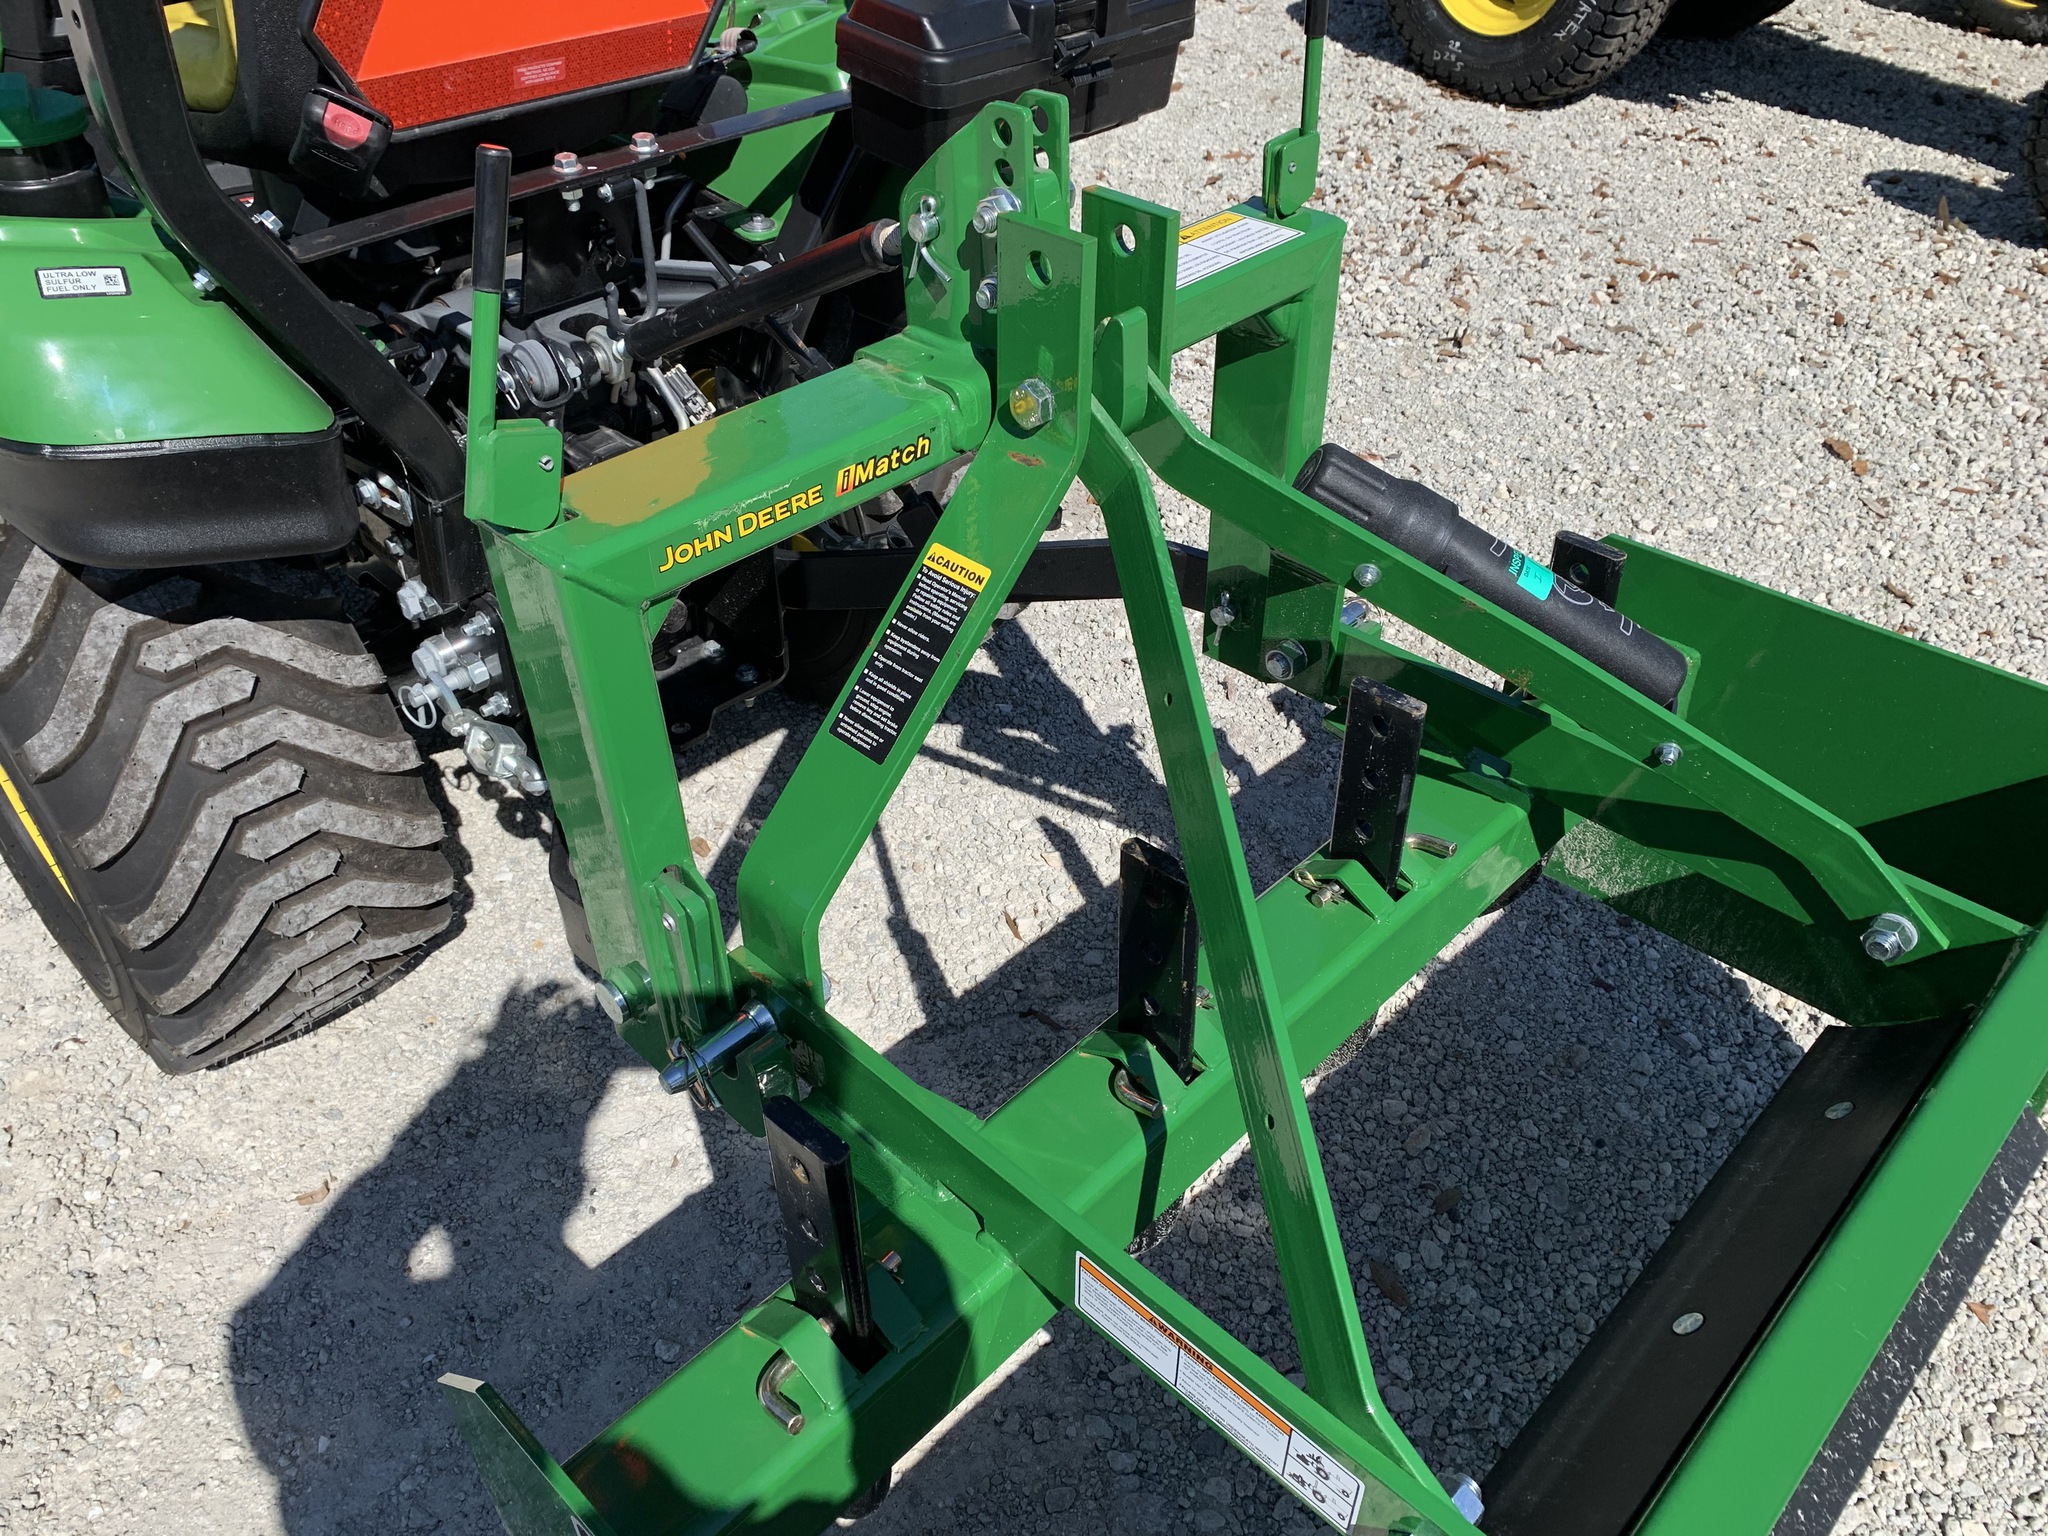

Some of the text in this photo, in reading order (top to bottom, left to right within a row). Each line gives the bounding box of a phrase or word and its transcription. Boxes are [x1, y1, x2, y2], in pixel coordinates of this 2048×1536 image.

[1553, 0, 1597, 41] ATER
[659, 525, 733, 573] JOHN
[737, 484, 824, 538] DEERE
[935, 555, 985, 586] CAUTION
[928, 571, 942, 580] Avoid
[942, 578, 960, 590] Serious
[960, 587, 976, 598] Injury:
[897, 621, 908, 629] Never
[891, 632, 900, 640] Keep
[921, 650, 931, 658] away
[878, 655, 892, 665] Operate
[869, 671, 878, 679] Keep
[859, 688, 871, 697] Lower
[871, 696, 890, 708] equipment
[877, 684, 887, 692] good
[850, 705, 861, 714] before
[843, 716, 854, 724] Never
[864, 729, 879, 740] children
[887, 720, 898, 729] brake
[1155, 1320, 1214, 1372] WARNING
